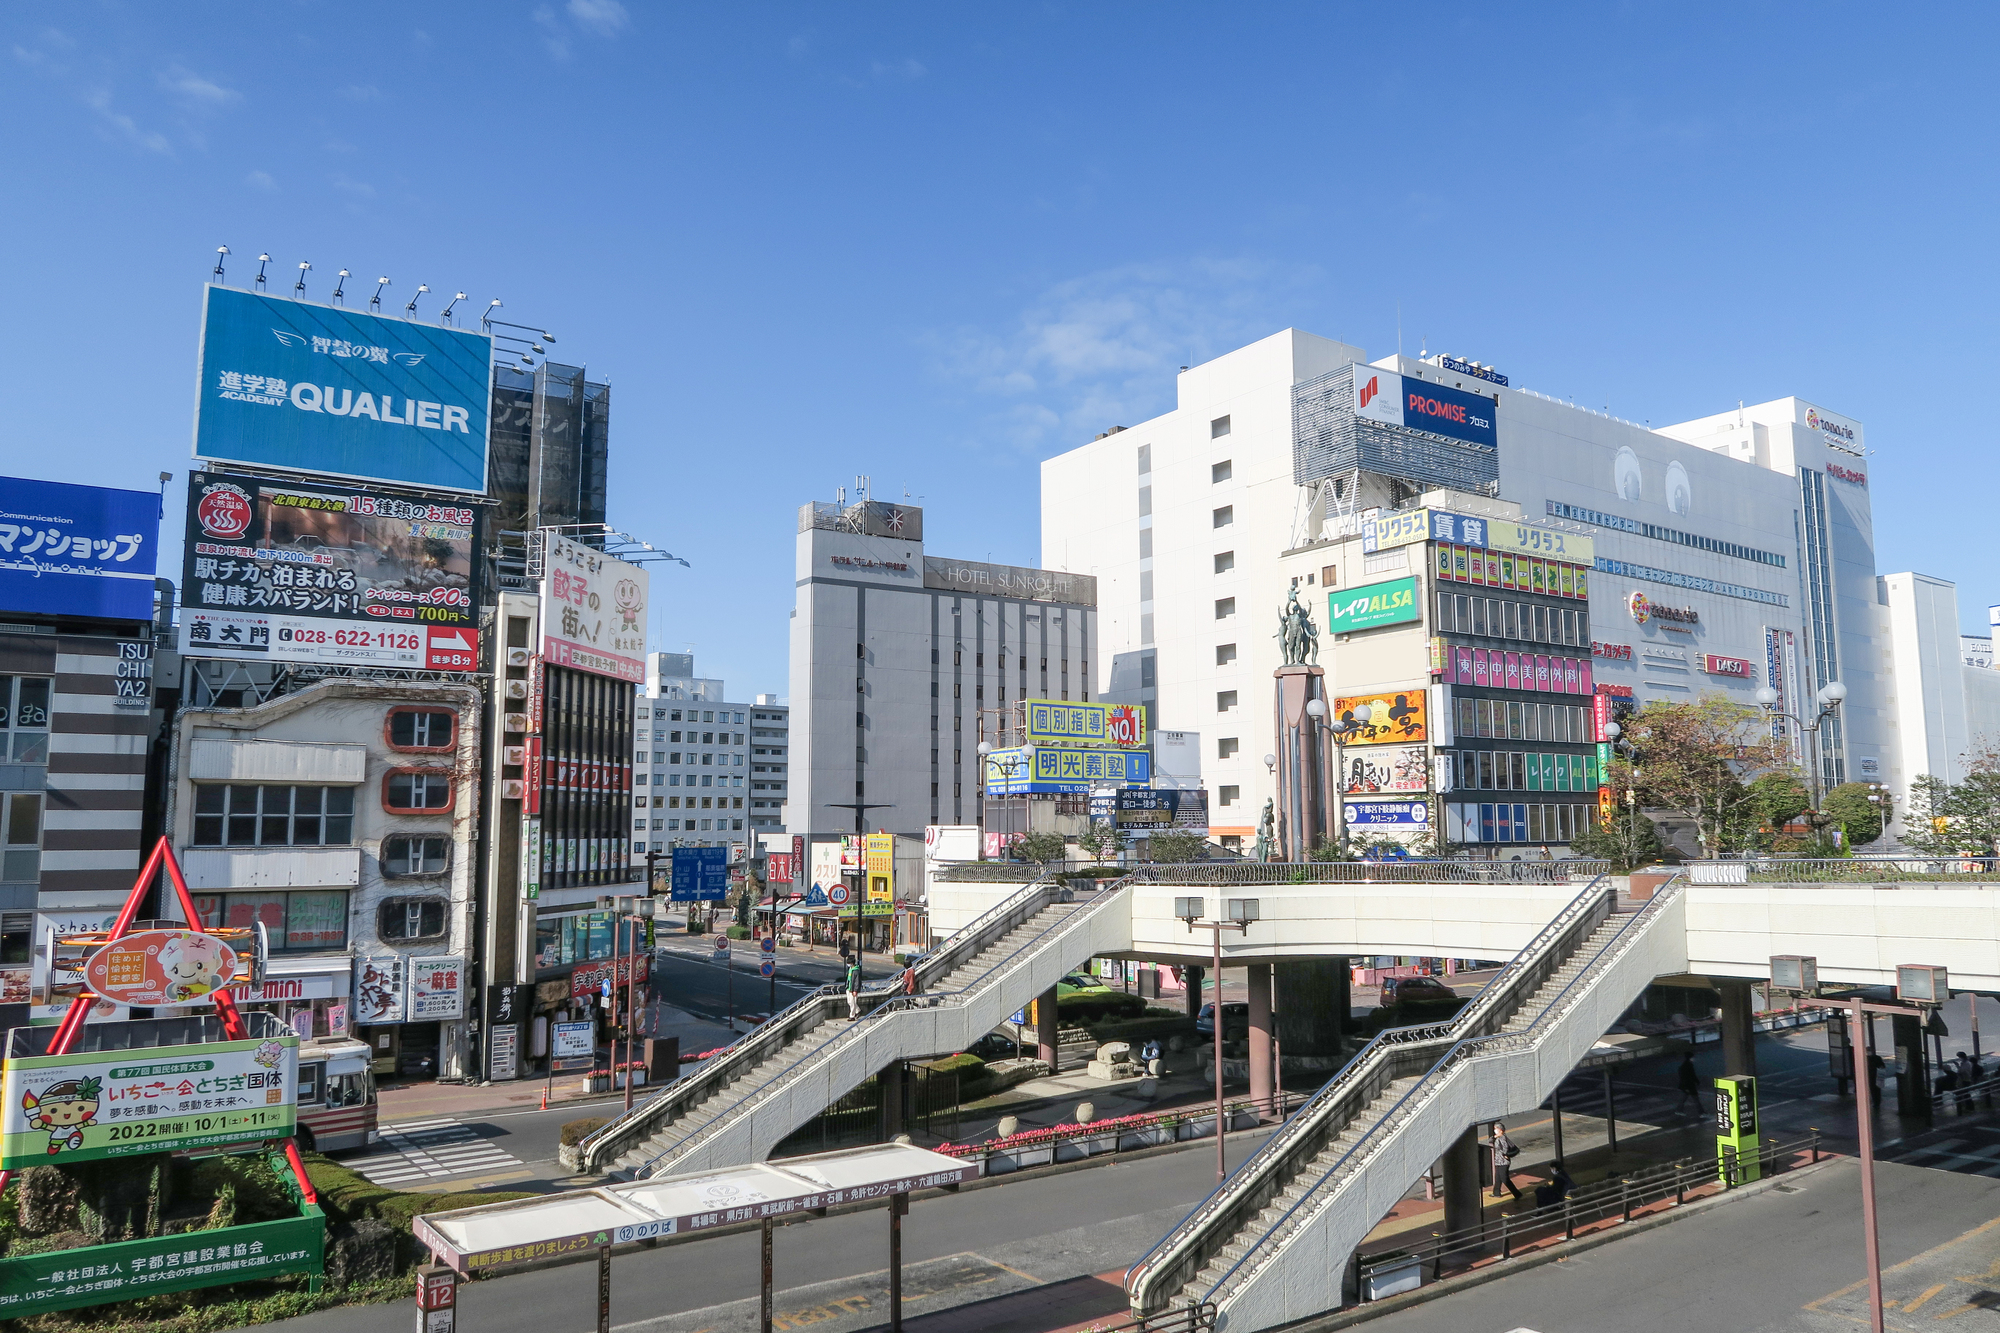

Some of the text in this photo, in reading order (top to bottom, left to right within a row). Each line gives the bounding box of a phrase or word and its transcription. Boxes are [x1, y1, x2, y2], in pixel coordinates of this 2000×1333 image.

[312, 335, 389, 365] 智慧の翼
[1443, 358, 1507, 385] うつのみや ララ・ステージ
[219, 370, 287, 397] 進学塾
[219, 391, 284, 407] ACADEMY
[290, 382, 470, 434] QUALIER
[1409, 394, 1466, 423] PROMISE
[1469, 415, 1490, 429] プロミス
[208, 498, 243, 511] 天然温泉
[274, 494, 346, 512] 北関東最大級
[351, 496, 475, 525] 15種類のお風呂
[1379, 513, 1425, 540] リクラス
[1434, 513, 1483, 545] 賃貸
[1517, 527, 1566, 554] リクラス
[554, 539, 603, 575] ようこそ!
[195, 557, 356, 591] 駅チカ・泊まれる
[948, 567, 1071, 595] HOTEL SUNROUTE
[202, 582, 361, 614] 健康スパランド!
[553, 568, 600, 611] 餃子の
[1334, 589, 1413, 619] レイクALSA
[190, 620, 270, 645] 南大門
[562, 606, 602, 643] 街へ!
[117, 642, 150, 659] TSU
[294, 629, 420, 650] 028-622-1126
[431, 654, 472, 666] 徒歩8分
[550, 642, 569, 663] 1F
[115, 661, 146, 678] CHI
[619, 660, 643, 682] 中央店
[1460, 658, 1577, 684] 東京中央美容外科
[1716, 659, 1742, 674] DAISO
[115, 680, 146, 697] YA2
[113, 697, 145, 706] BUILDING
[1035, 709, 1101, 733] 個別指導
[1109, 709, 1142, 741] NO.1
[569, 765, 610, 787] アイフル
[1370, 814, 1398, 823] クリニック
[816, 864, 837, 878] クスリ
[110, 964, 142, 972] 愉快だ
[111, 954, 144, 963] 住めば
[417, 963, 458, 971] オールグリーン
[110, 974, 141, 982] 宇都宮
[431, 971, 458, 990] 麻雀
[117, 1062, 207, 1078] 第77回 国民体育大会
[108, 1071, 283, 1102] いちご一会とちぎ国体
[109, 1096, 254, 1119] 夢を感動へ。感動を未来へ。
[638, 1220, 671, 1237] のりば
[37, 1240, 264, 1283] 一般社団法人 宇都宮建設業協会
[467, 1235, 589, 1268] 横断歩道を渡りましょう
[430, 1286, 451, 1307] 12
